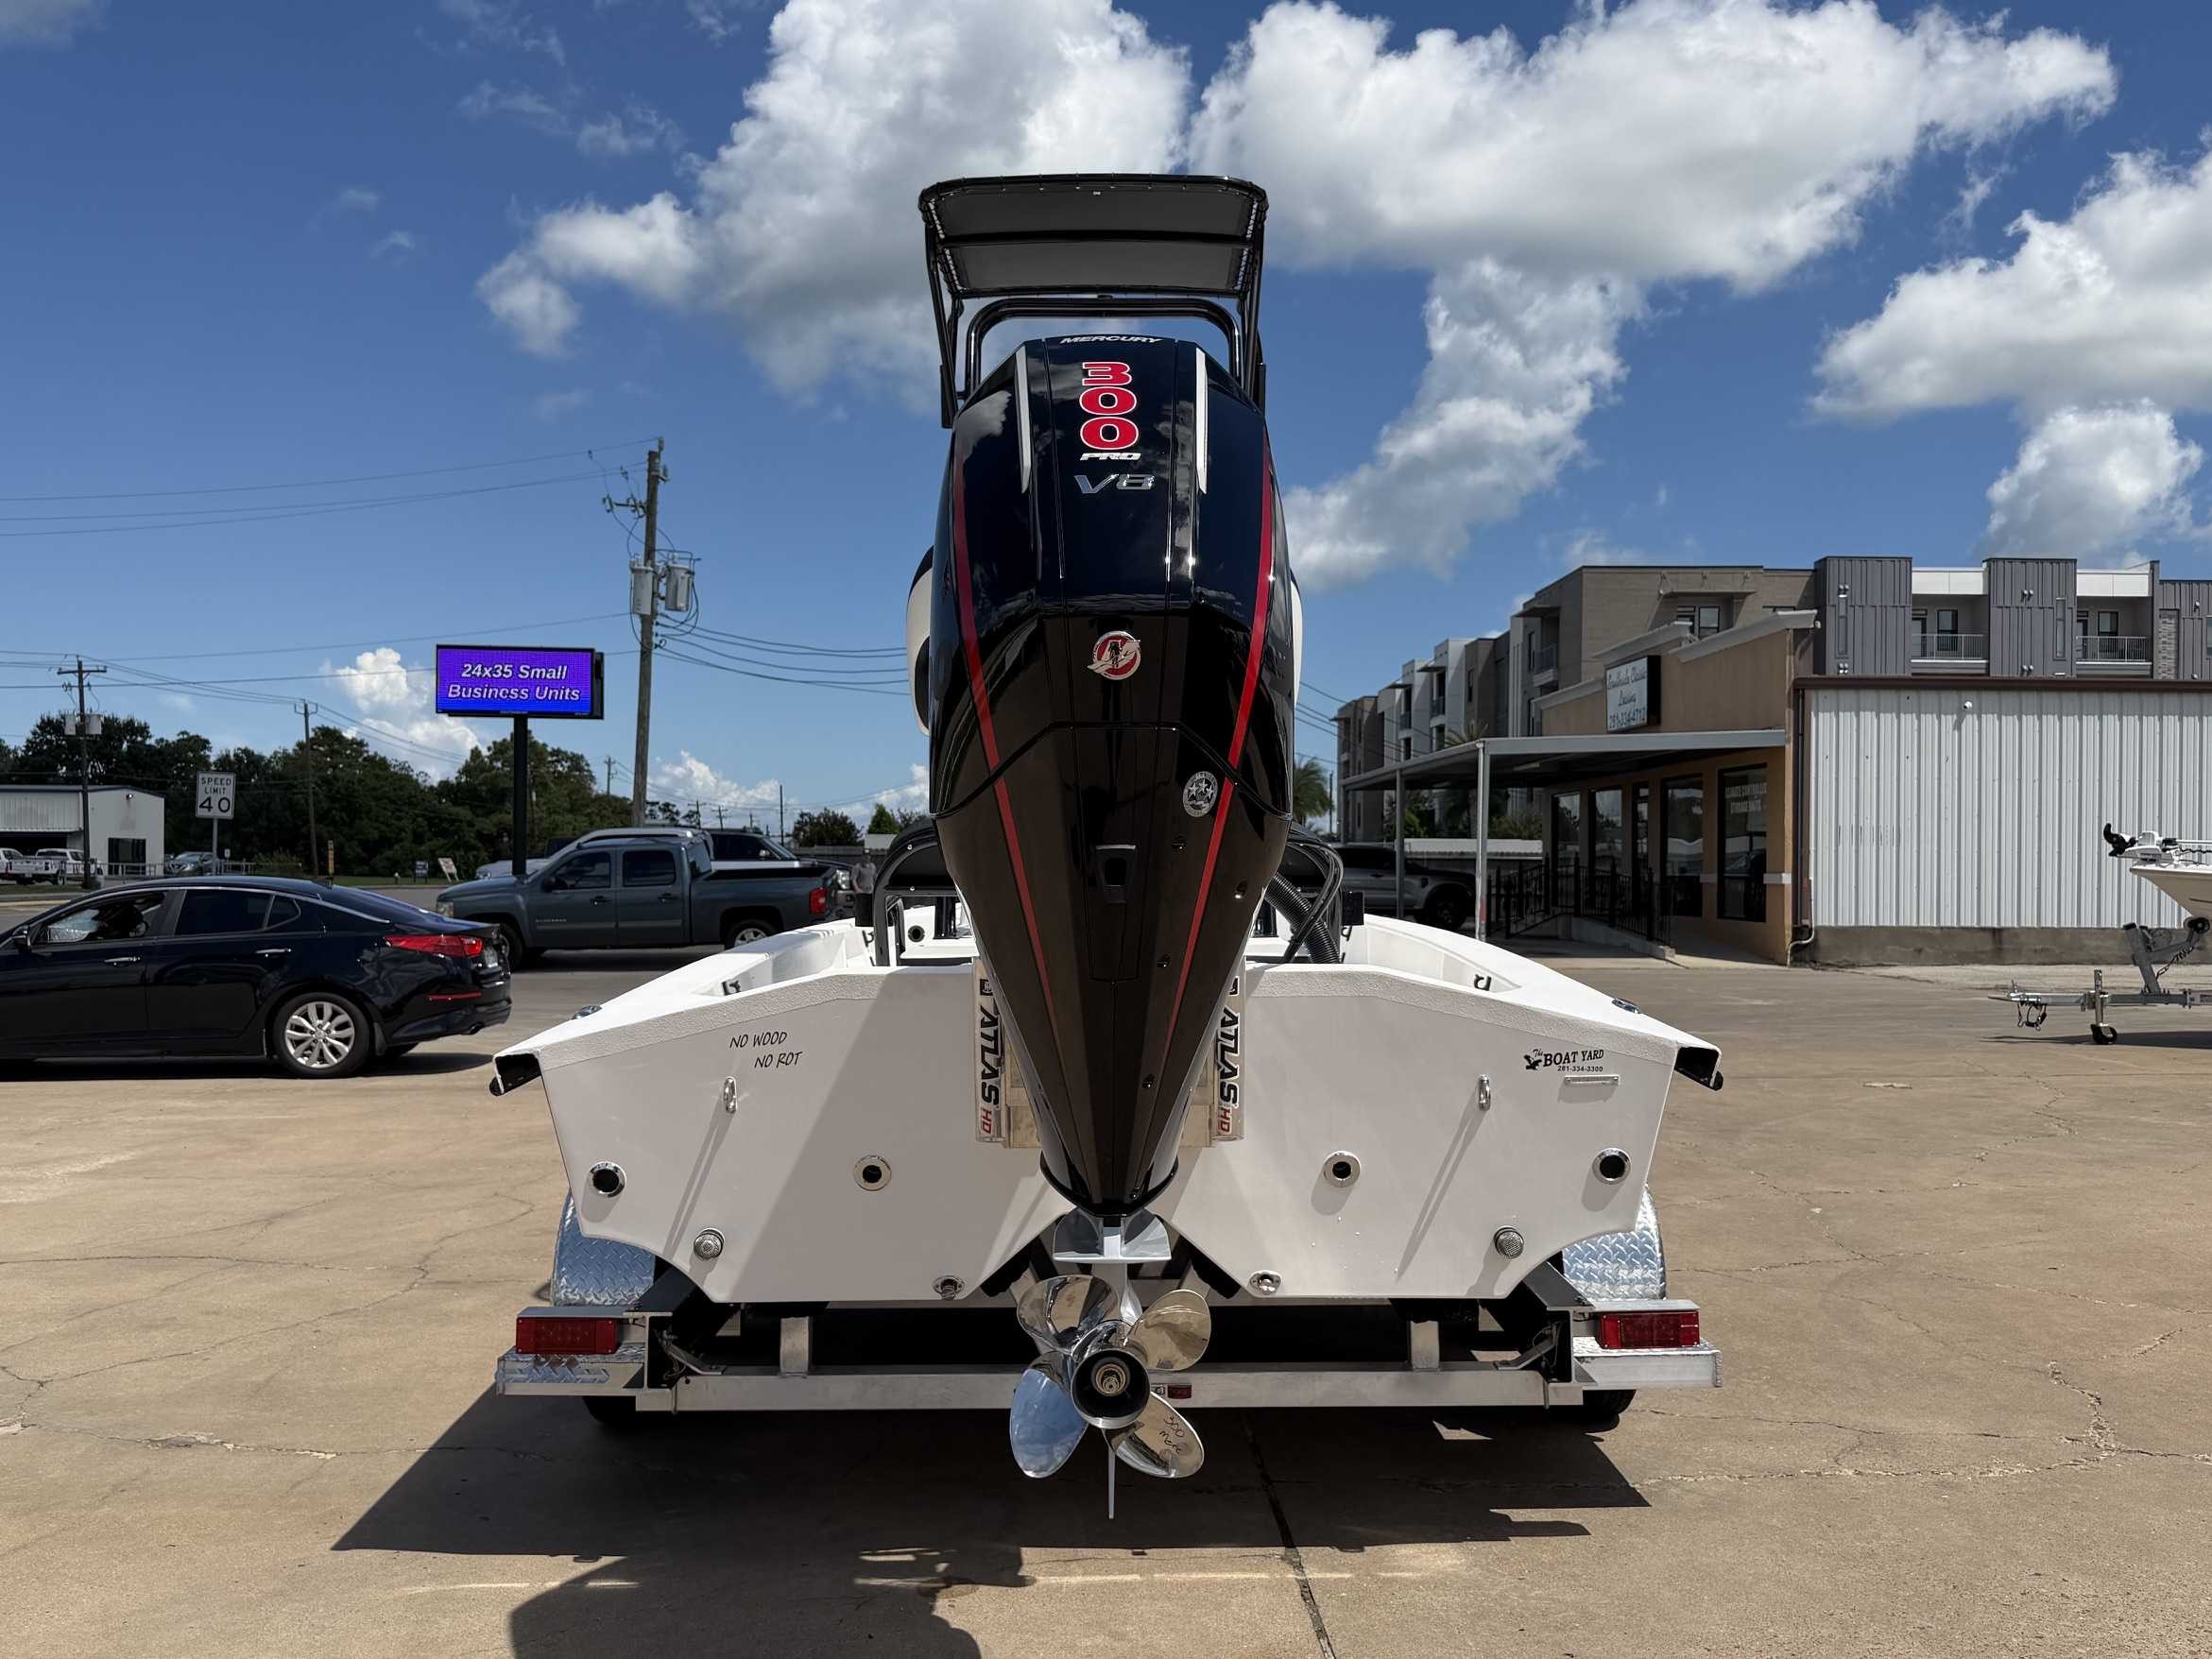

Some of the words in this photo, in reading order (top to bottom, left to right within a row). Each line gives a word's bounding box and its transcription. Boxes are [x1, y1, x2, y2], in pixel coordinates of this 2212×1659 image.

[1059, 335, 1164, 344] MERCURY
[1079, 362, 1139, 451] 300
[1080, 453, 1140, 461] PRO
[1073, 473, 1155, 494] V8
[461, 663, 513, 678] 24x35
[519, 665, 568, 680] Small
[448, 684, 529, 700] Business
[535, 686, 580, 701] Units
[200, 777, 231, 785] SPEED
[204, 786, 226, 795] LIMIT
[198, 796, 231, 812] 40
[729, 1034, 749, 1049] NO
[753, 1031, 788, 1047] WOOD
[754, 1053, 774, 1069] NO
[776, 1051, 803, 1069] ROT
[980, 1004, 1000, 1105] ATLAS
[1220, 1006, 1240, 1104] ATLAS
[1543, 1051, 1579, 1067] BOAT
[1581, 1049, 1604, 1061] YARD
[983, 1108, 992, 1134] HD
[1218, 1108, 1231, 1134] HD
[1163, 1415, 1185, 1438] 300
